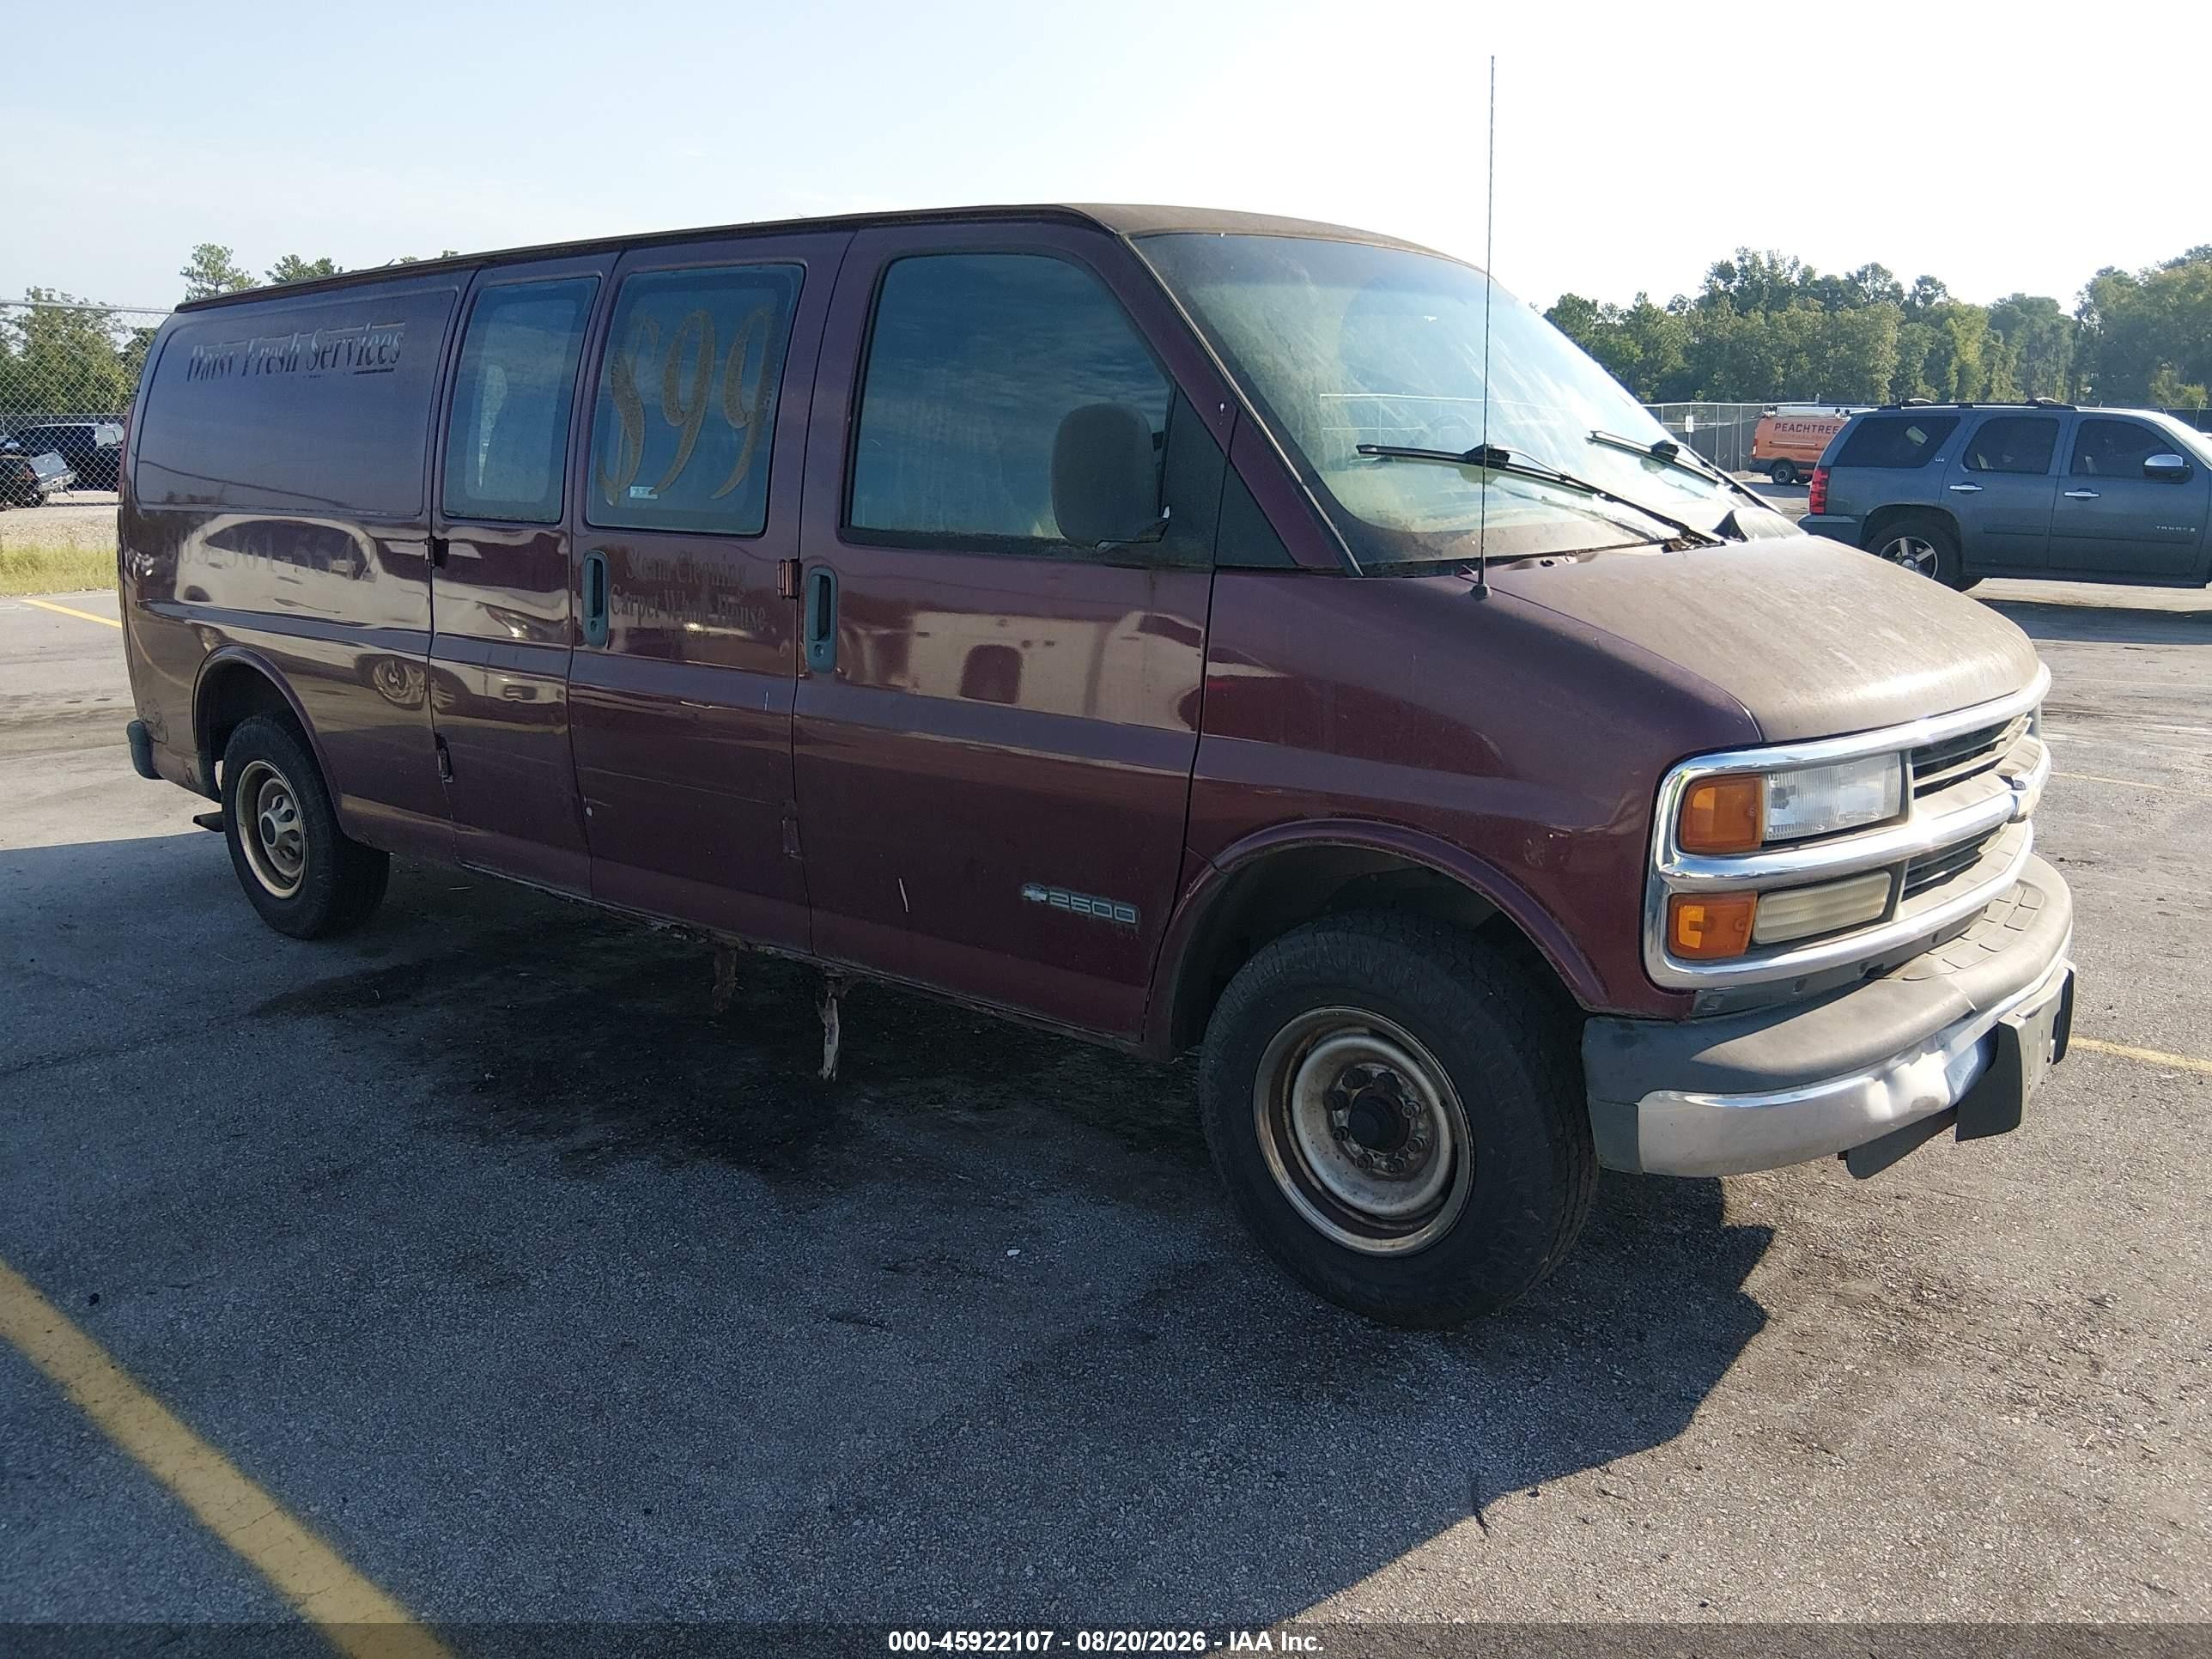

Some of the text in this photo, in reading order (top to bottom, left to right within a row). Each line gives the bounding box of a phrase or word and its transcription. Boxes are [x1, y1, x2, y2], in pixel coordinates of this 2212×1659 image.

[306, 323, 404, 370] Services
[1774, 422, 1839, 434] PEACHTREE
[611, 584, 660, 626] Carpet
[1048, 891, 1137, 924] 2500
